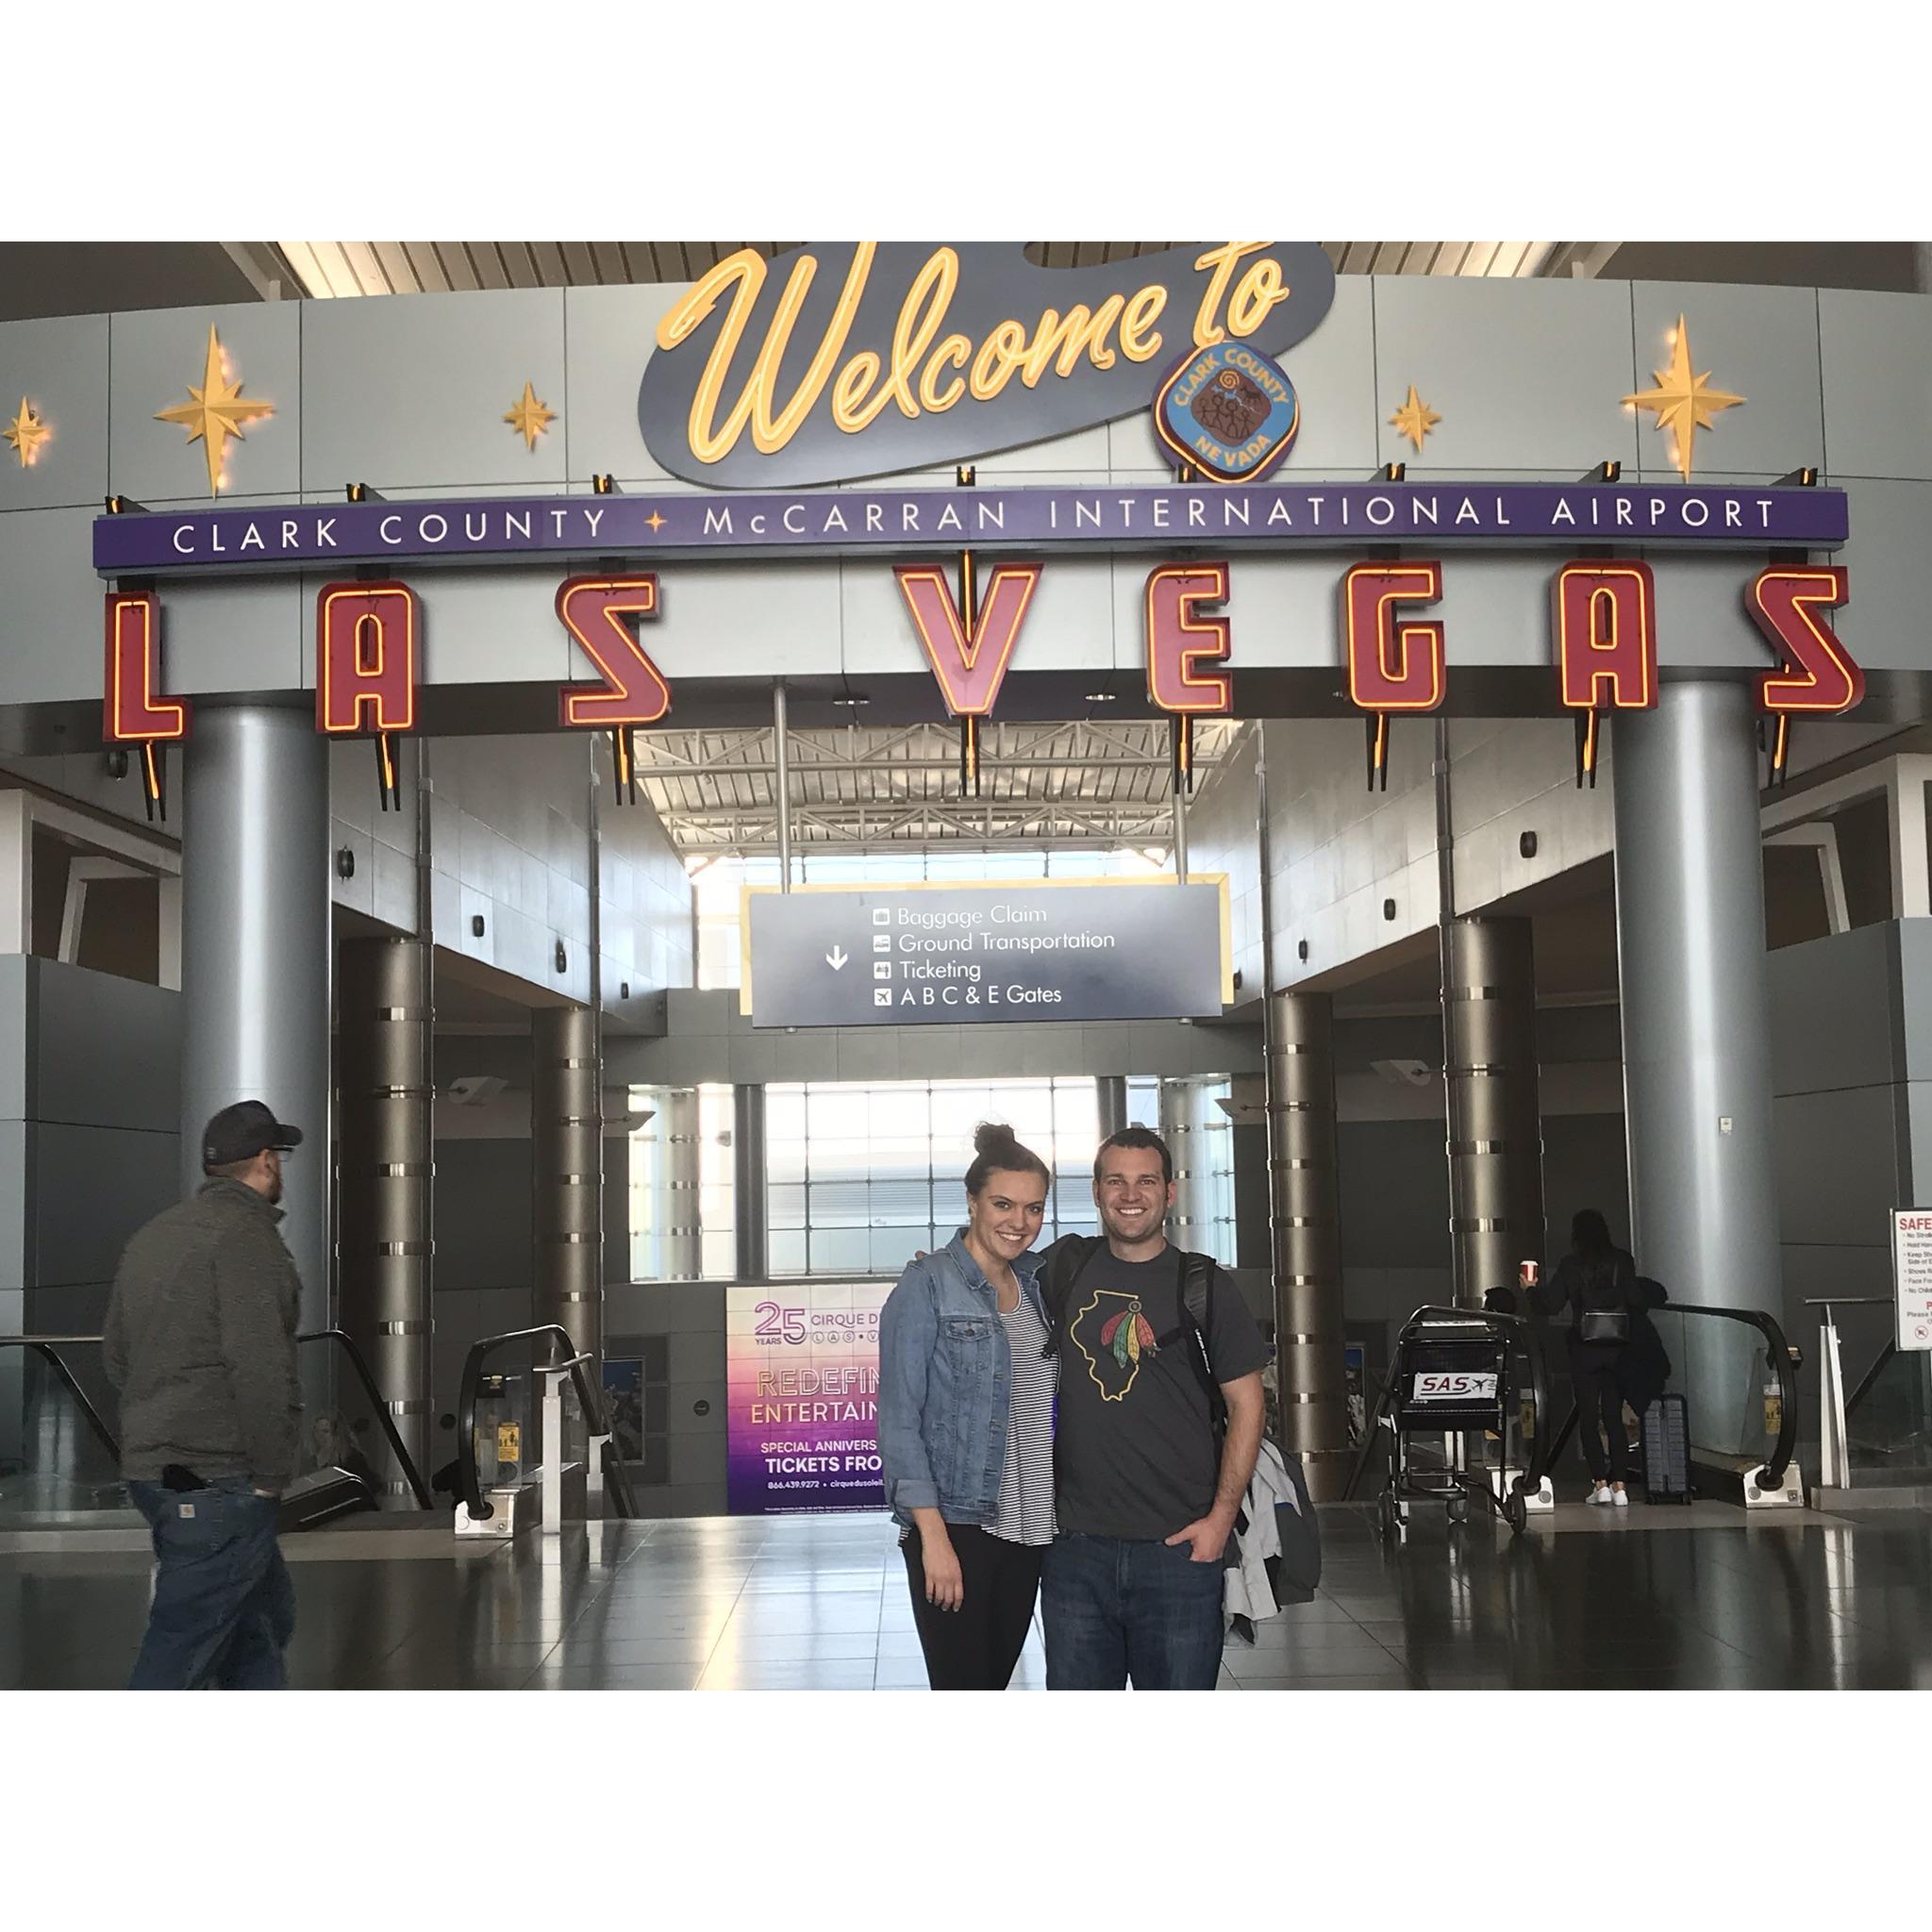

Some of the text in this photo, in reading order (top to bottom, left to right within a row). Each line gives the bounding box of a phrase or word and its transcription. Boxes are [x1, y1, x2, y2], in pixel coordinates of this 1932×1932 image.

[658, 242, 1167, 462] Welcome
[1174, 348, 1289, 407] CLARK COUNTY
[1195, 434, 1272, 467] NEVADA
[173, 495, 1773, 554] CLARK COUNTY McCARRAN INTERNATIONAL AIRPORT
[104, 560, 1865, 741] LAS VEGAS
[897, 905, 1047, 928] Baggage Claim
[898, 931, 1115, 954] Ground Transportation
[899, 959, 981, 982] Ticketing
[989, 986, 999, 1003] E
[1007, 985, 1062, 1004] Gates
[755, 1302, 806, 1344] 25
[811, 1314, 864, 1328] CIRQUE
[1421, 1376, 1470, 1391] SAS
[760, 1440, 877, 1454] SPECIAL ANNIVERS
[765, 1455, 883, 1474] TICKETS FRO
